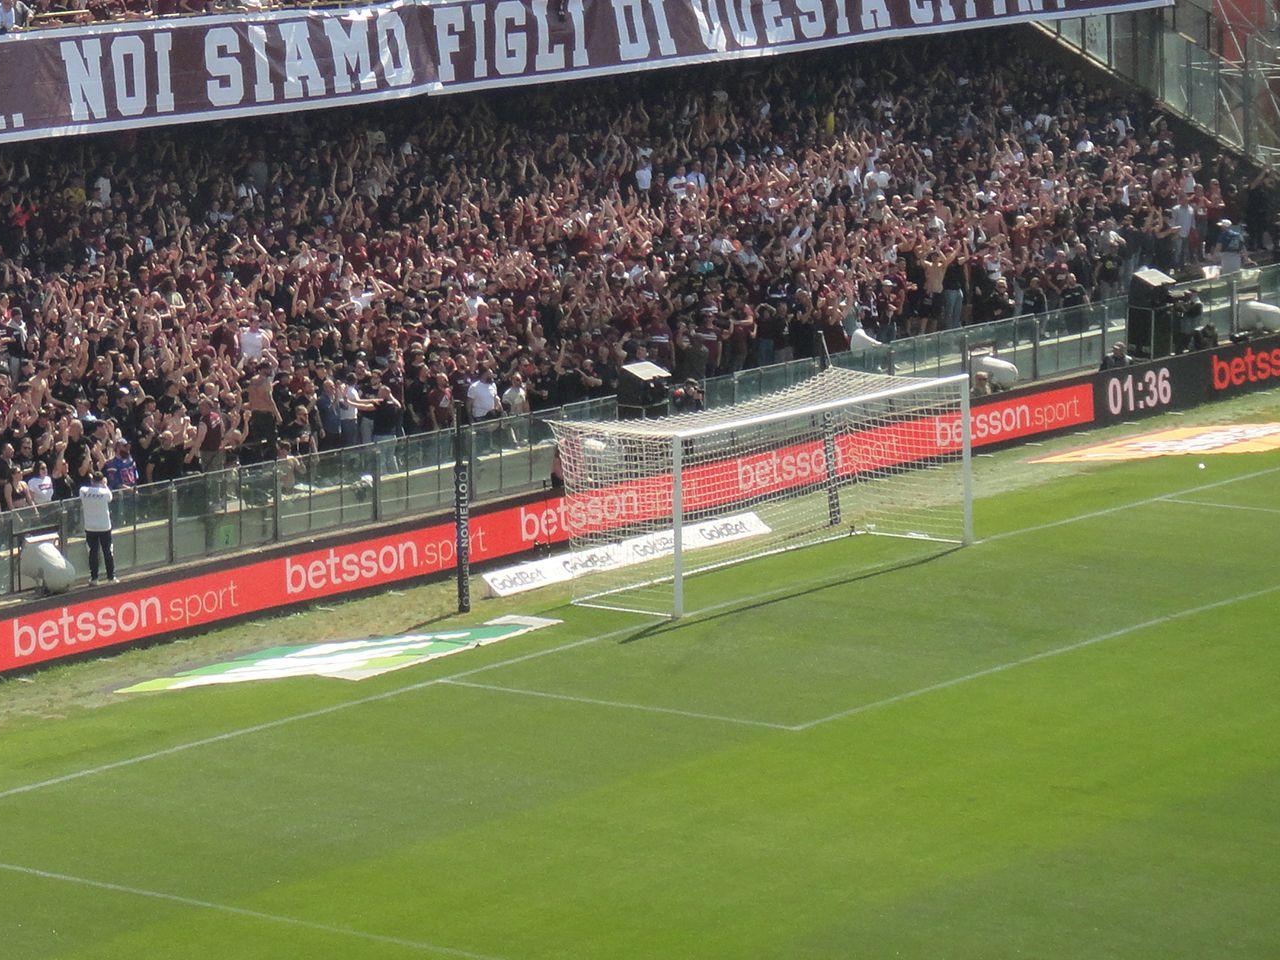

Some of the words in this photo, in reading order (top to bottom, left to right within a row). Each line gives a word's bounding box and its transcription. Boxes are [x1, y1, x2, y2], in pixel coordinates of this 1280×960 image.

[60, 31, 176, 123] NOI
[204, 10, 415, 107] SIAMO
[1107, 366, 1172, 416] 01:36
[459, 483, 469, 547] NOVIELLO
[286, 526, 489, 595] betsson.sprt
[13, 580, 240, 658] betsson.sport
